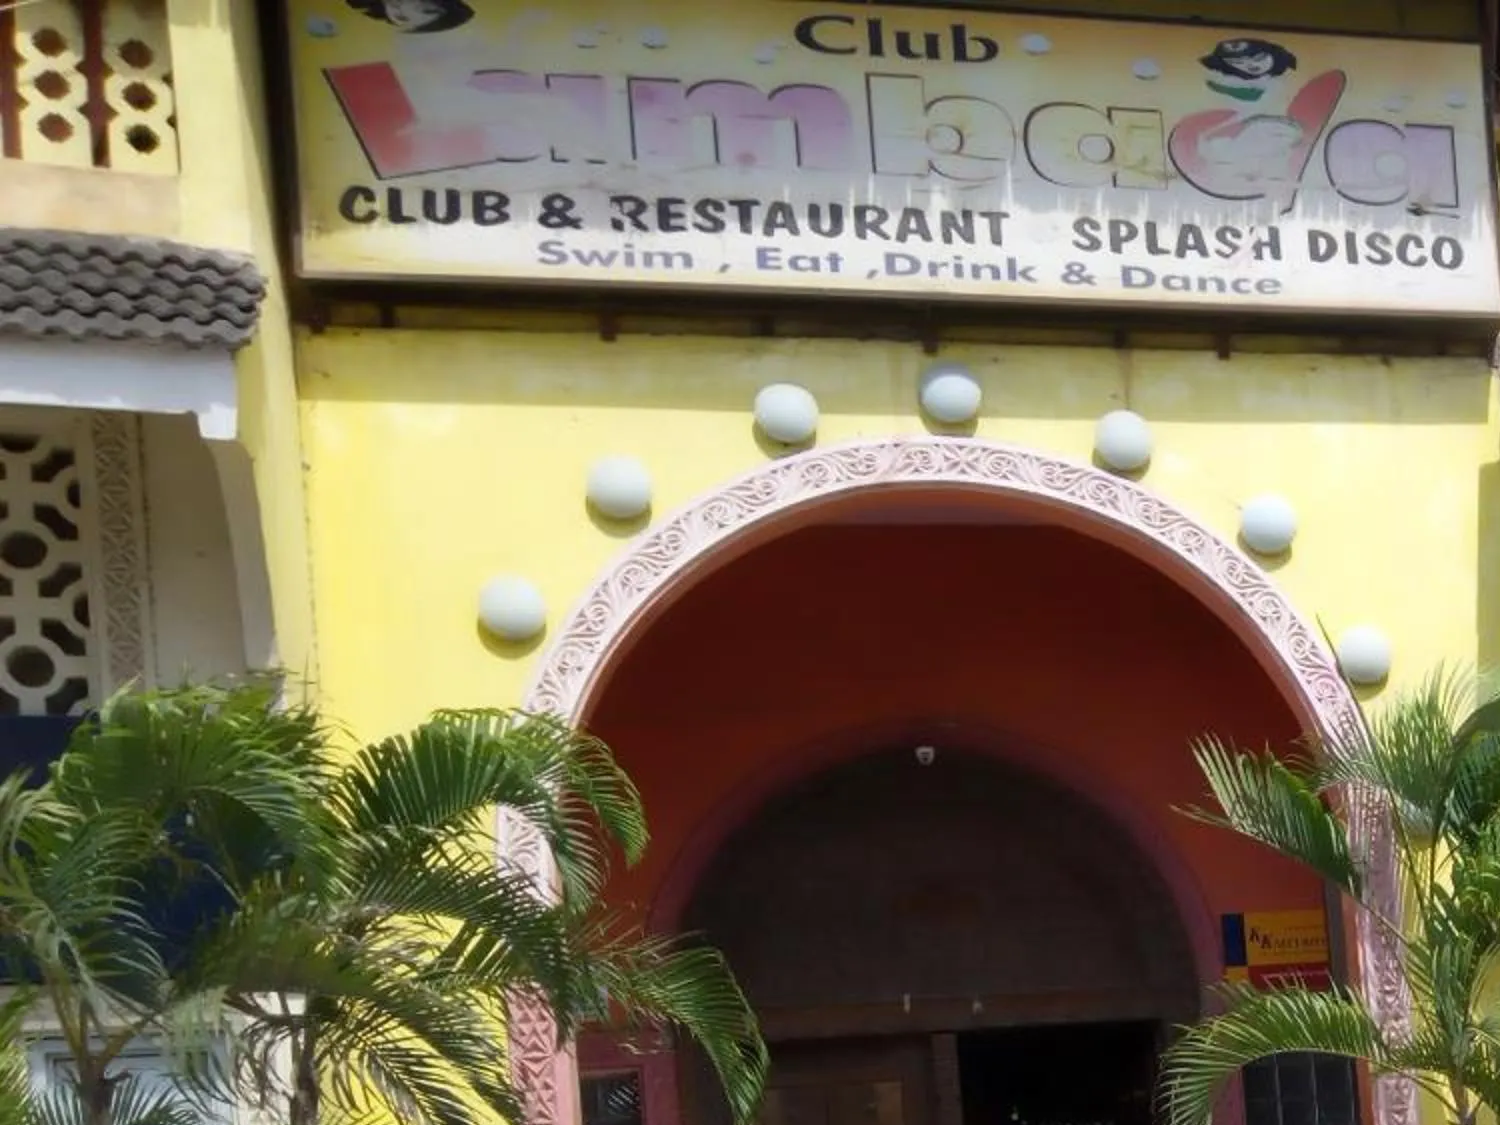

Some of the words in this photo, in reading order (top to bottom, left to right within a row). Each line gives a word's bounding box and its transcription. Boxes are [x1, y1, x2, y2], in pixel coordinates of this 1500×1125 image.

[794, 15, 999, 64] Club
[338, 186, 510, 226] CLUB
[537, 194, 582, 232] &
[610, 195, 1010, 245] RESTAURANT
[1072, 216, 1282, 263] SPLASH
[1307, 229, 1464, 270] DISCO
[537, 240, 693, 270] Swim
[756, 245, 844, 273] Eat
[1060, 262, 1098, 286] &
[1120, 264, 1283, 296] Dance
